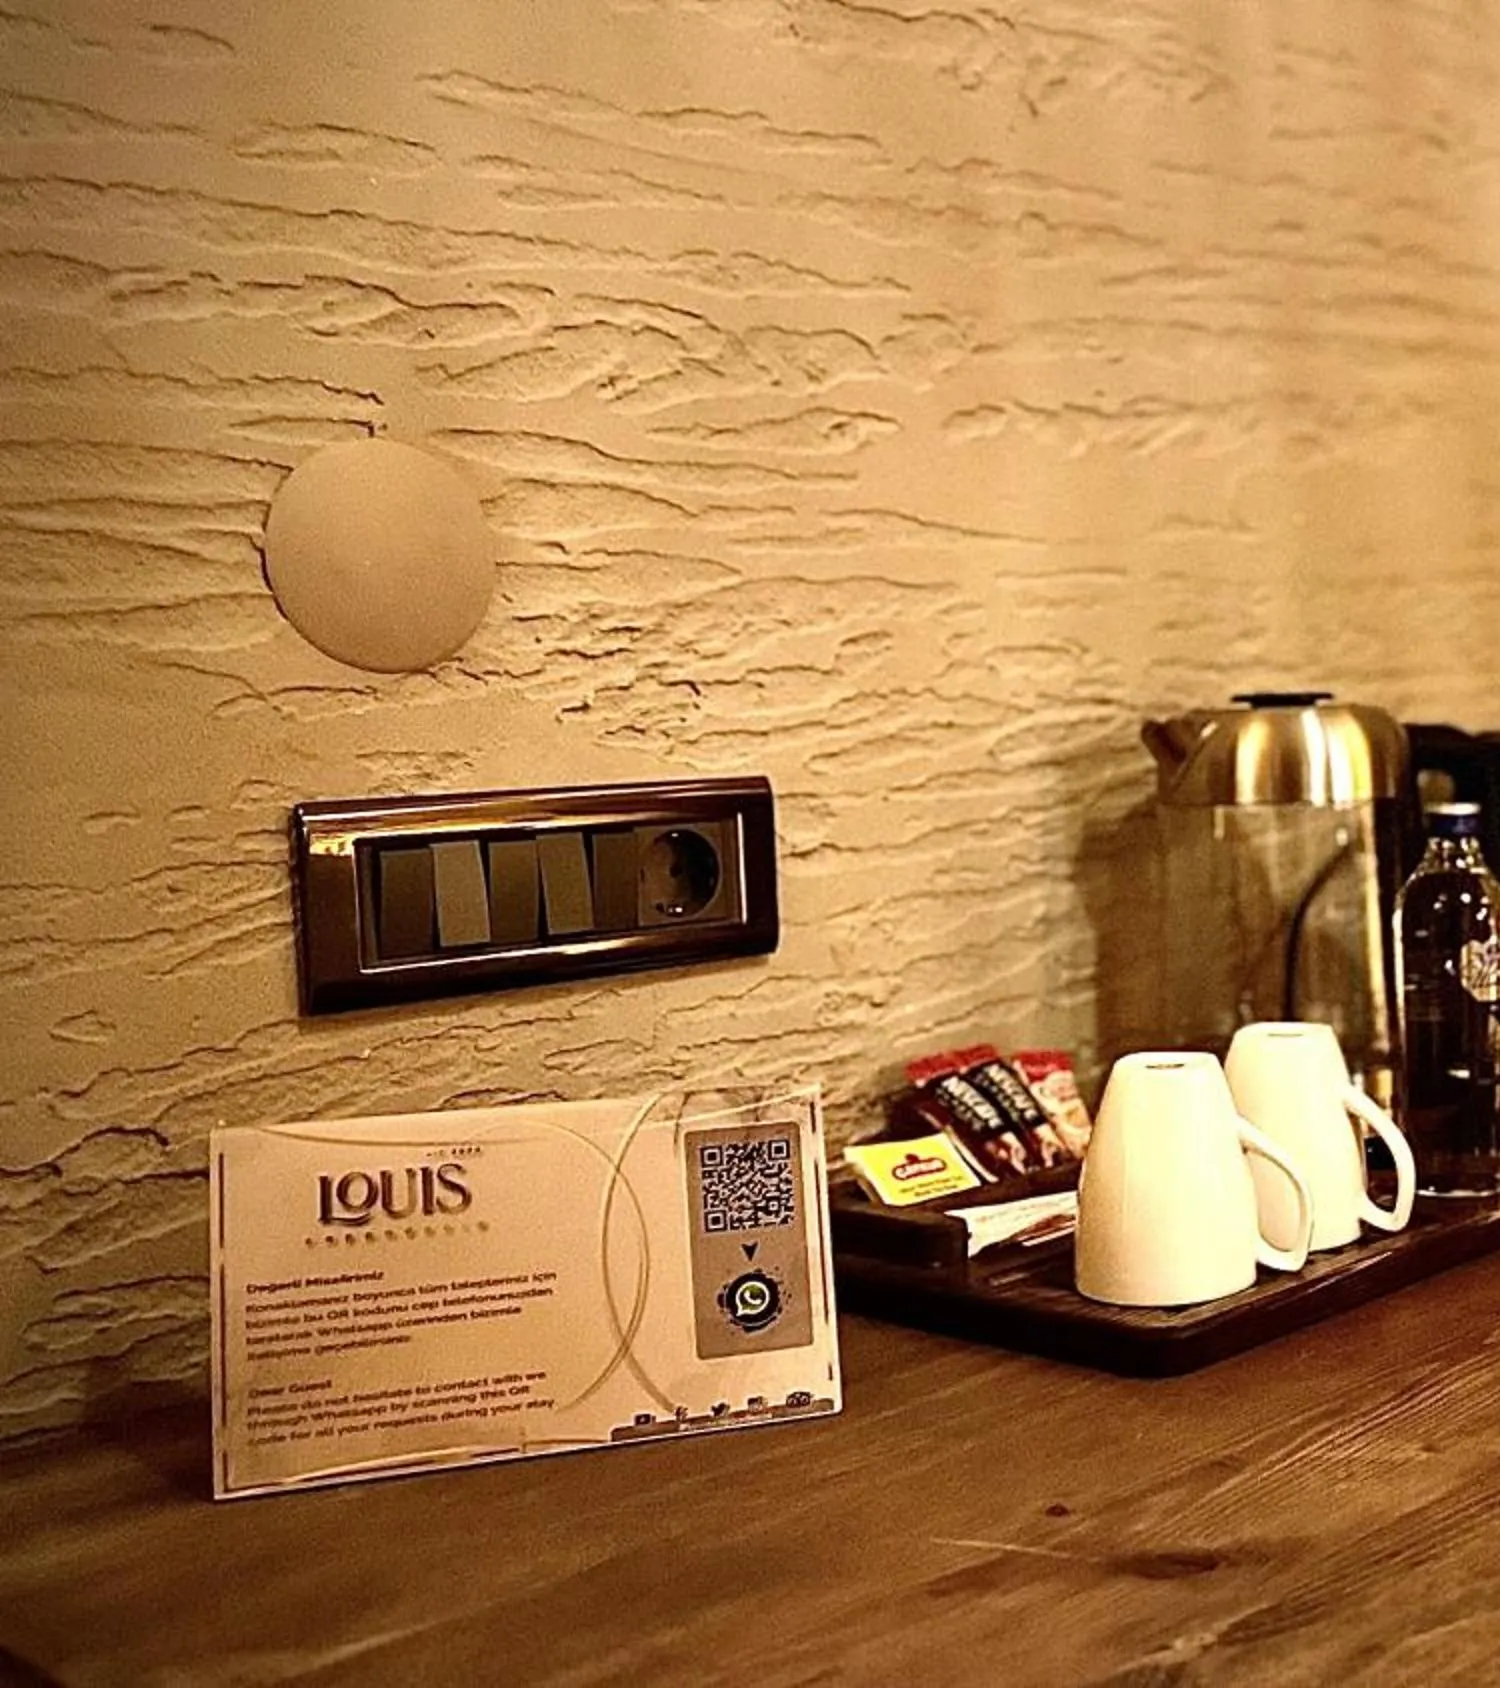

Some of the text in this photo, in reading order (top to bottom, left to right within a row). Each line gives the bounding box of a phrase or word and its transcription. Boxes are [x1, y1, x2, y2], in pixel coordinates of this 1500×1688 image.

[318, 1163, 473, 1228] LOUIS
[304, 1312, 324, 1323] bu
[327, 1309, 349, 1321] QR
[353, 1304, 409, 1317] kodunu
[411, 1301, 440, 1312] cep
[288, 1379, 333, 1394] Guest
[301, 1399, 322, 1410] do
[325, 1395, 349, 1406] not
[415, 1384, 431, 1395] to
[434, 1377, 488, 1393] contact
[492, 1372, 523, 1385] with
[391, 1401, 408, 1413] by
[412, 1392, 477, 1408] scanning
[480, 1387, 506, 1400] this
[509, 1385, 531, 1396] QR
[290, 1430, 311, 1441] for
[314, 1427, 334, 1438] all
[337, 1423, 369, 1438] your
[490, 1402, 521, 1417] your
